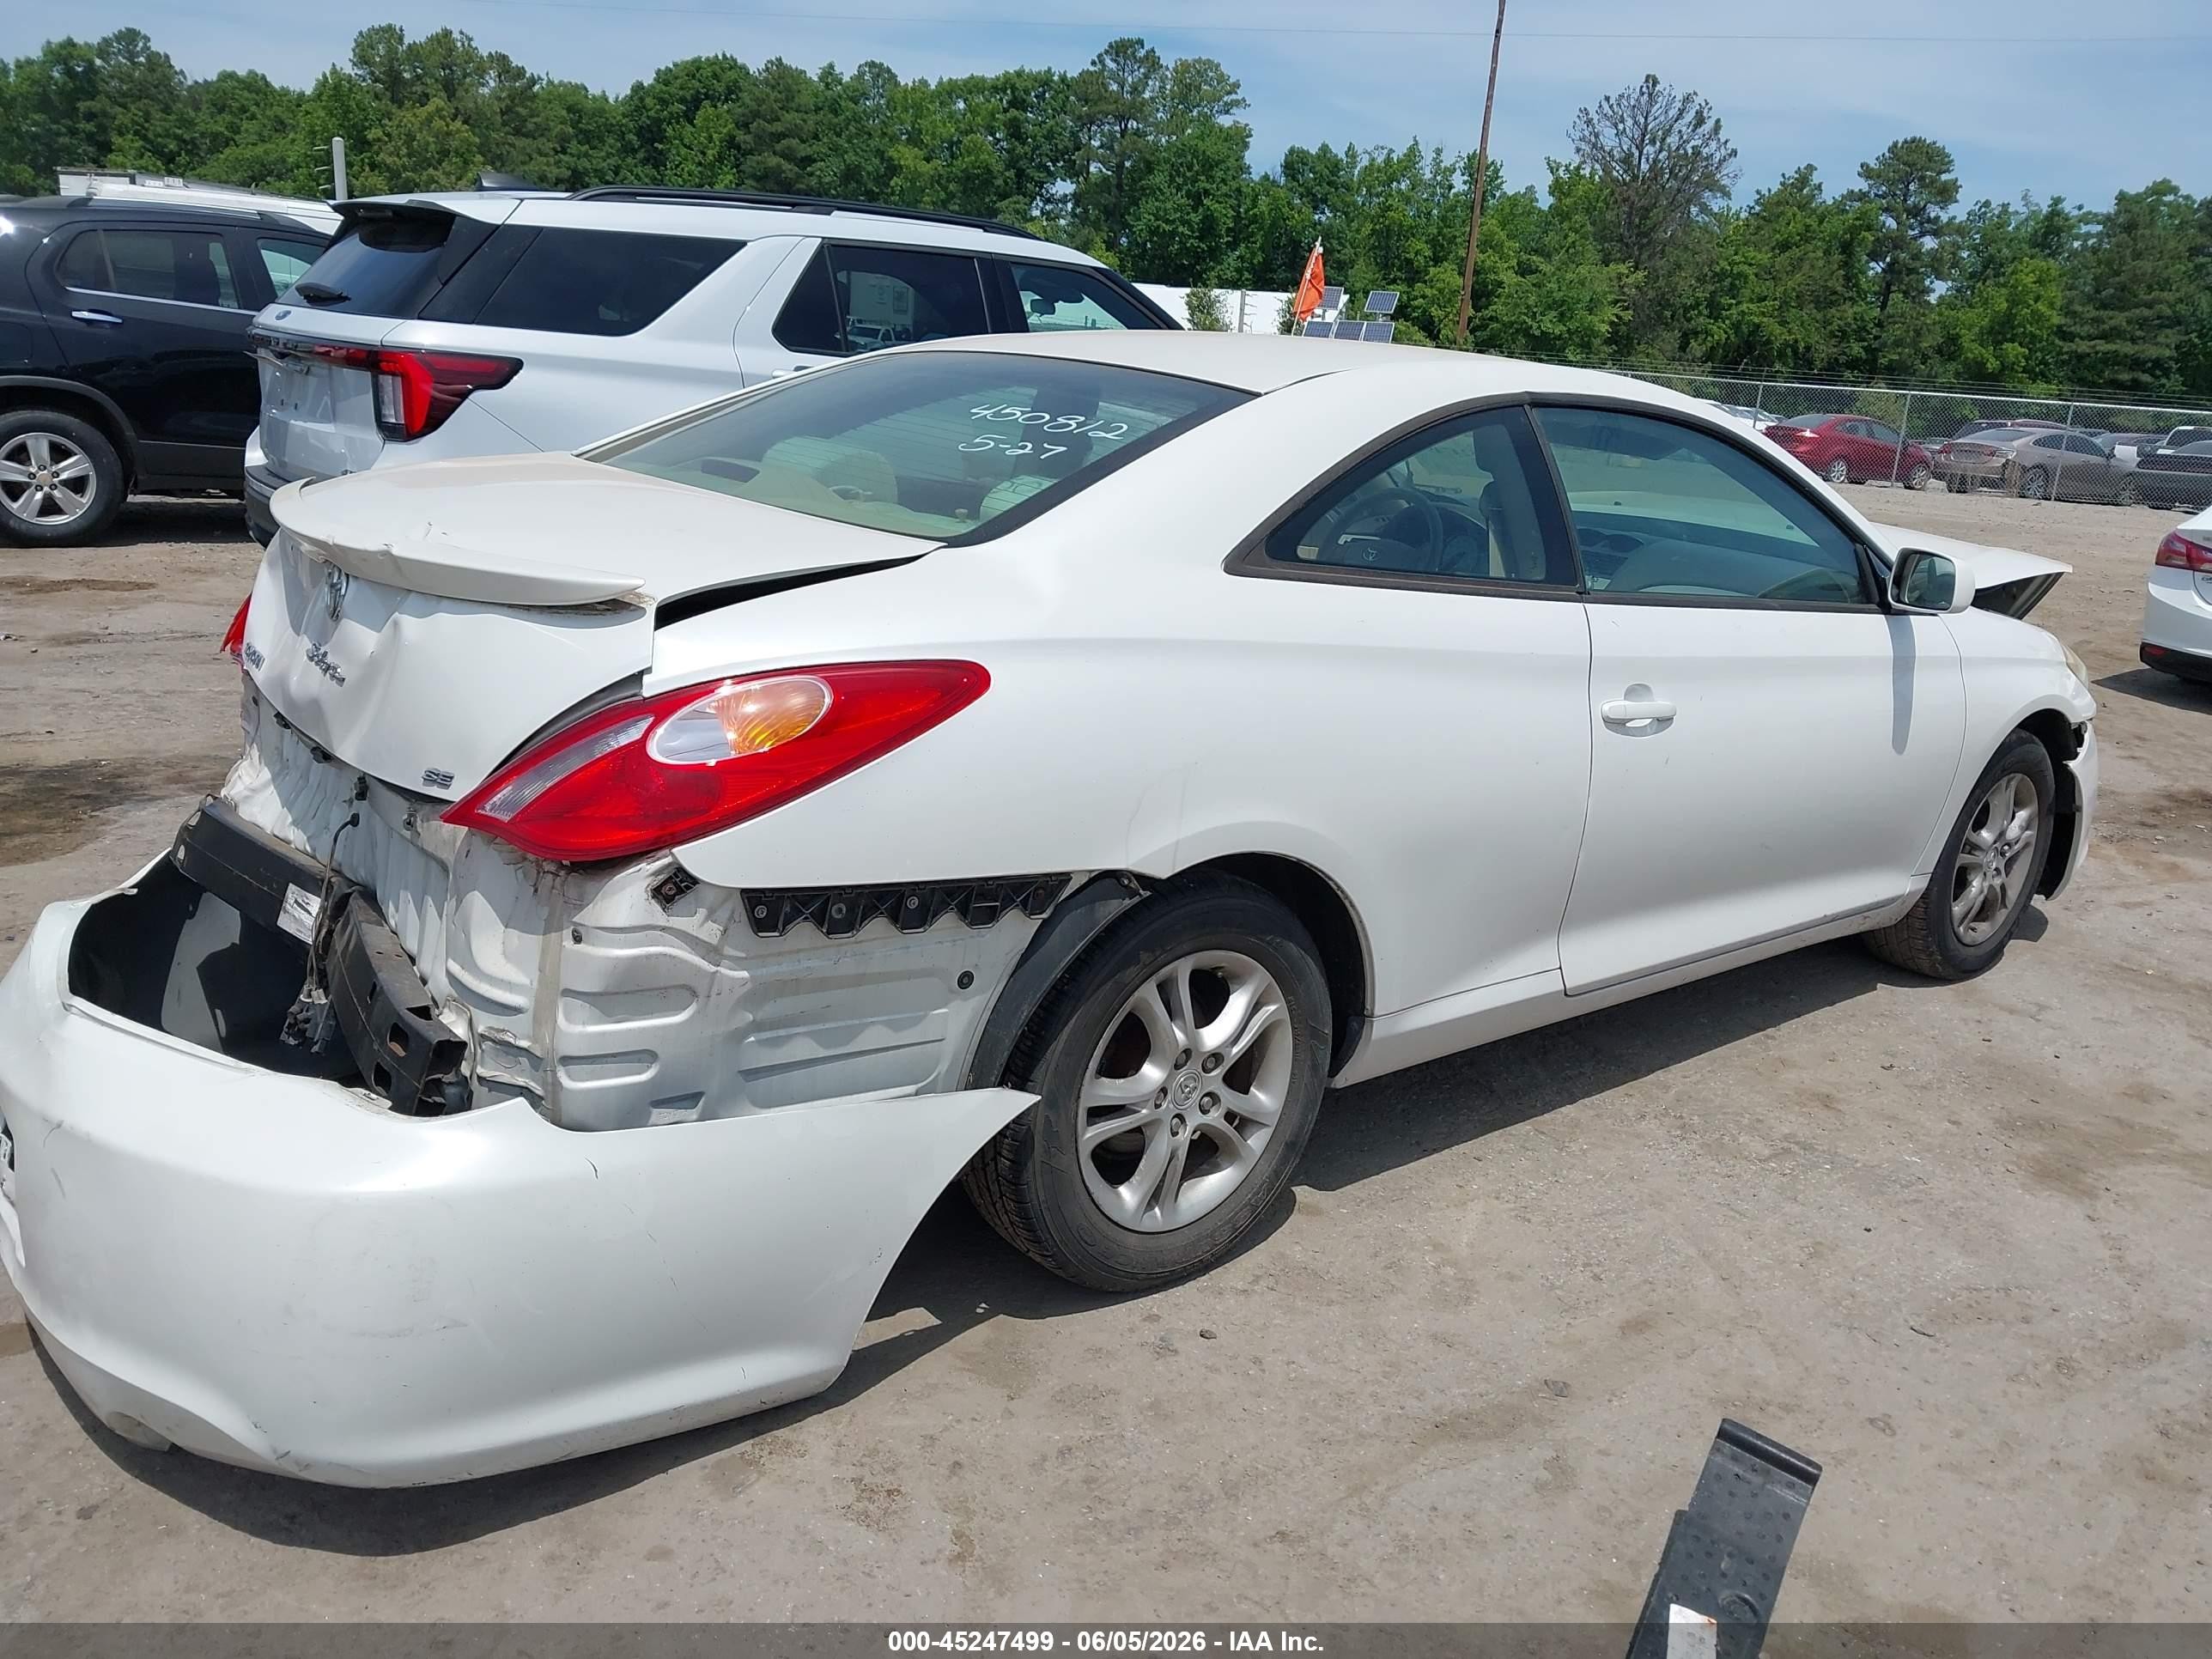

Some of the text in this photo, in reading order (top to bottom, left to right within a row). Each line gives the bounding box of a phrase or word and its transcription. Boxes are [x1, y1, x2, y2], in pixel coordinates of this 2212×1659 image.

[969, 404, 1129, 440] 450812
[957, 434, 1068, 459] 5-27
[421, 767, 454, 790] SE
